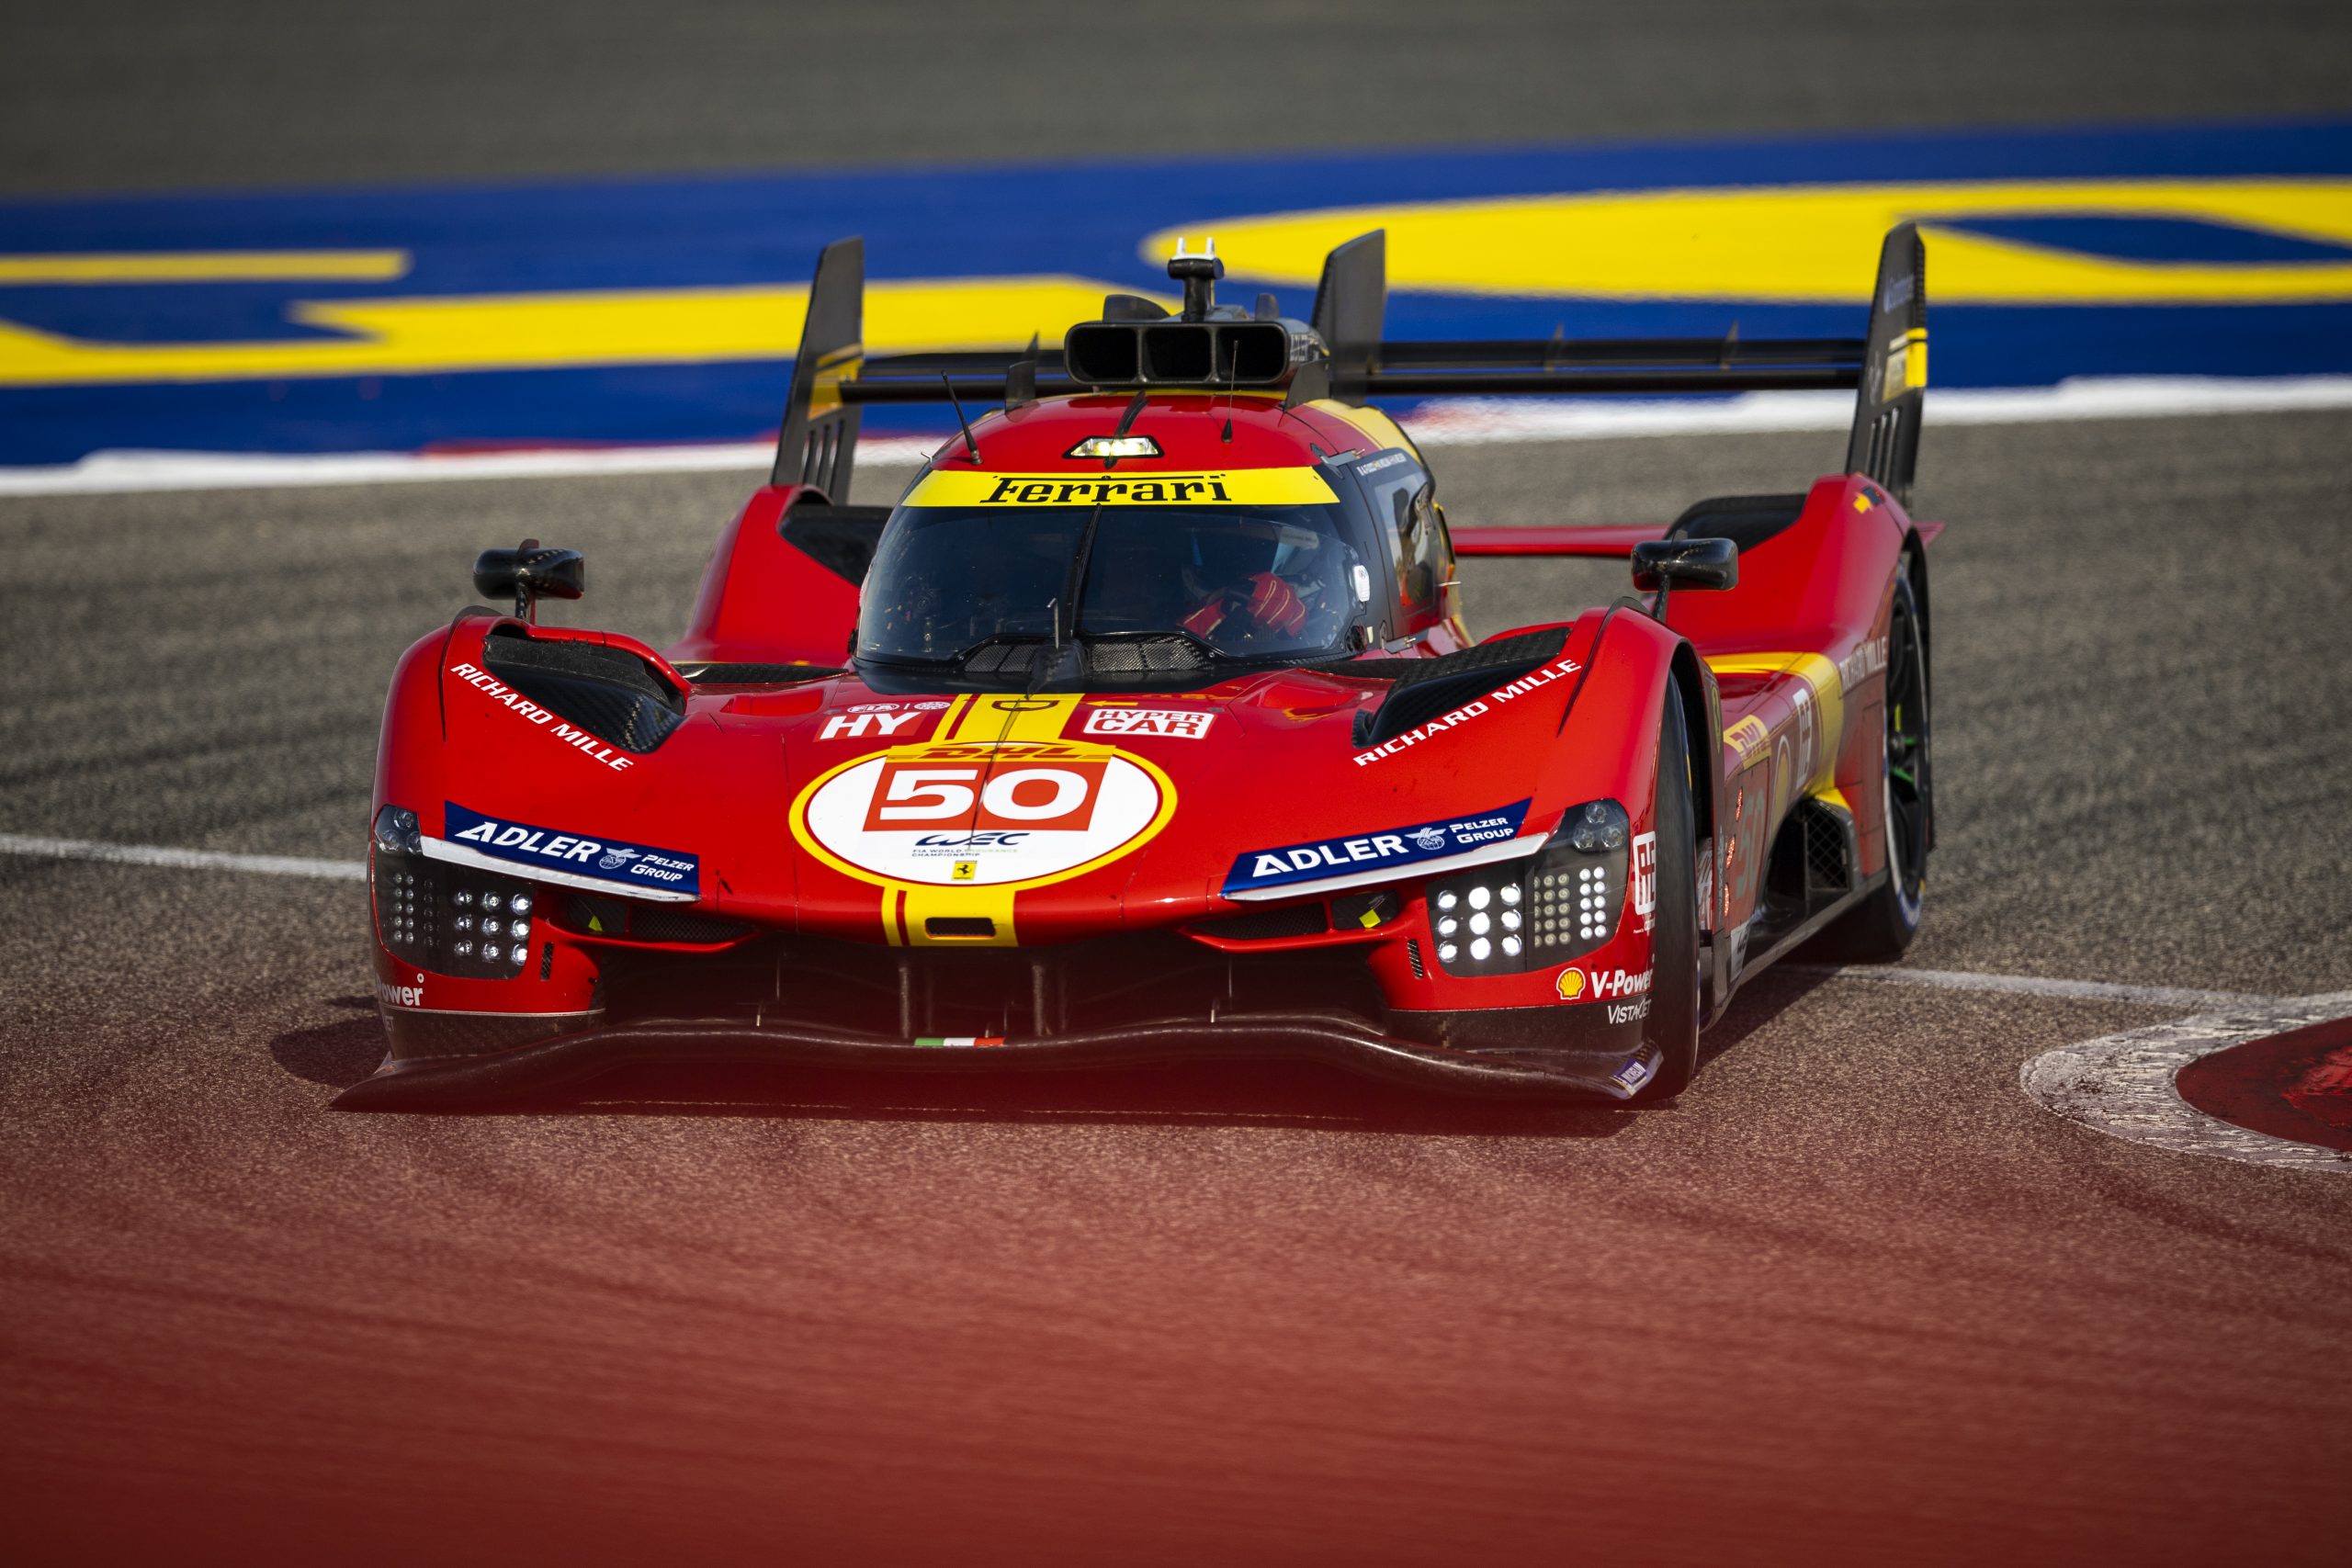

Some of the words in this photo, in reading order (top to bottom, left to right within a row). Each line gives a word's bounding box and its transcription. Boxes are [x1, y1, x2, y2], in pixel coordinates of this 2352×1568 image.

[979, 474, 1232, 503] Ferrari
[451, 663, 553, 724] RICHARD
[550, 723, 633, 771] MILLE
[1099, 711, 1204, 722] HYPER
[1353, 701, 1488, 766] RICHARD
[1491, 660, 1581, 703] MILLE
[820, 712, 922, 739] HY
[1093, 718, 1199, 735] CAR
[919, 748, 1079, 759] DHL
[880, 769, 1088, 820] 50
[1449, 818, 1509, 833] PELZER
[1456, 828, 1514, 843] GROUP
[455, 821, 601, 863] ADLER
[915, 832, 1030, 845] WEC
[641, 854, 695, 872] PELZER
[1252, 834, 1408, 877] ADLER
[630, 864, 683, 882] GROUP
[1591, 968, 1653, 998] V-Power
